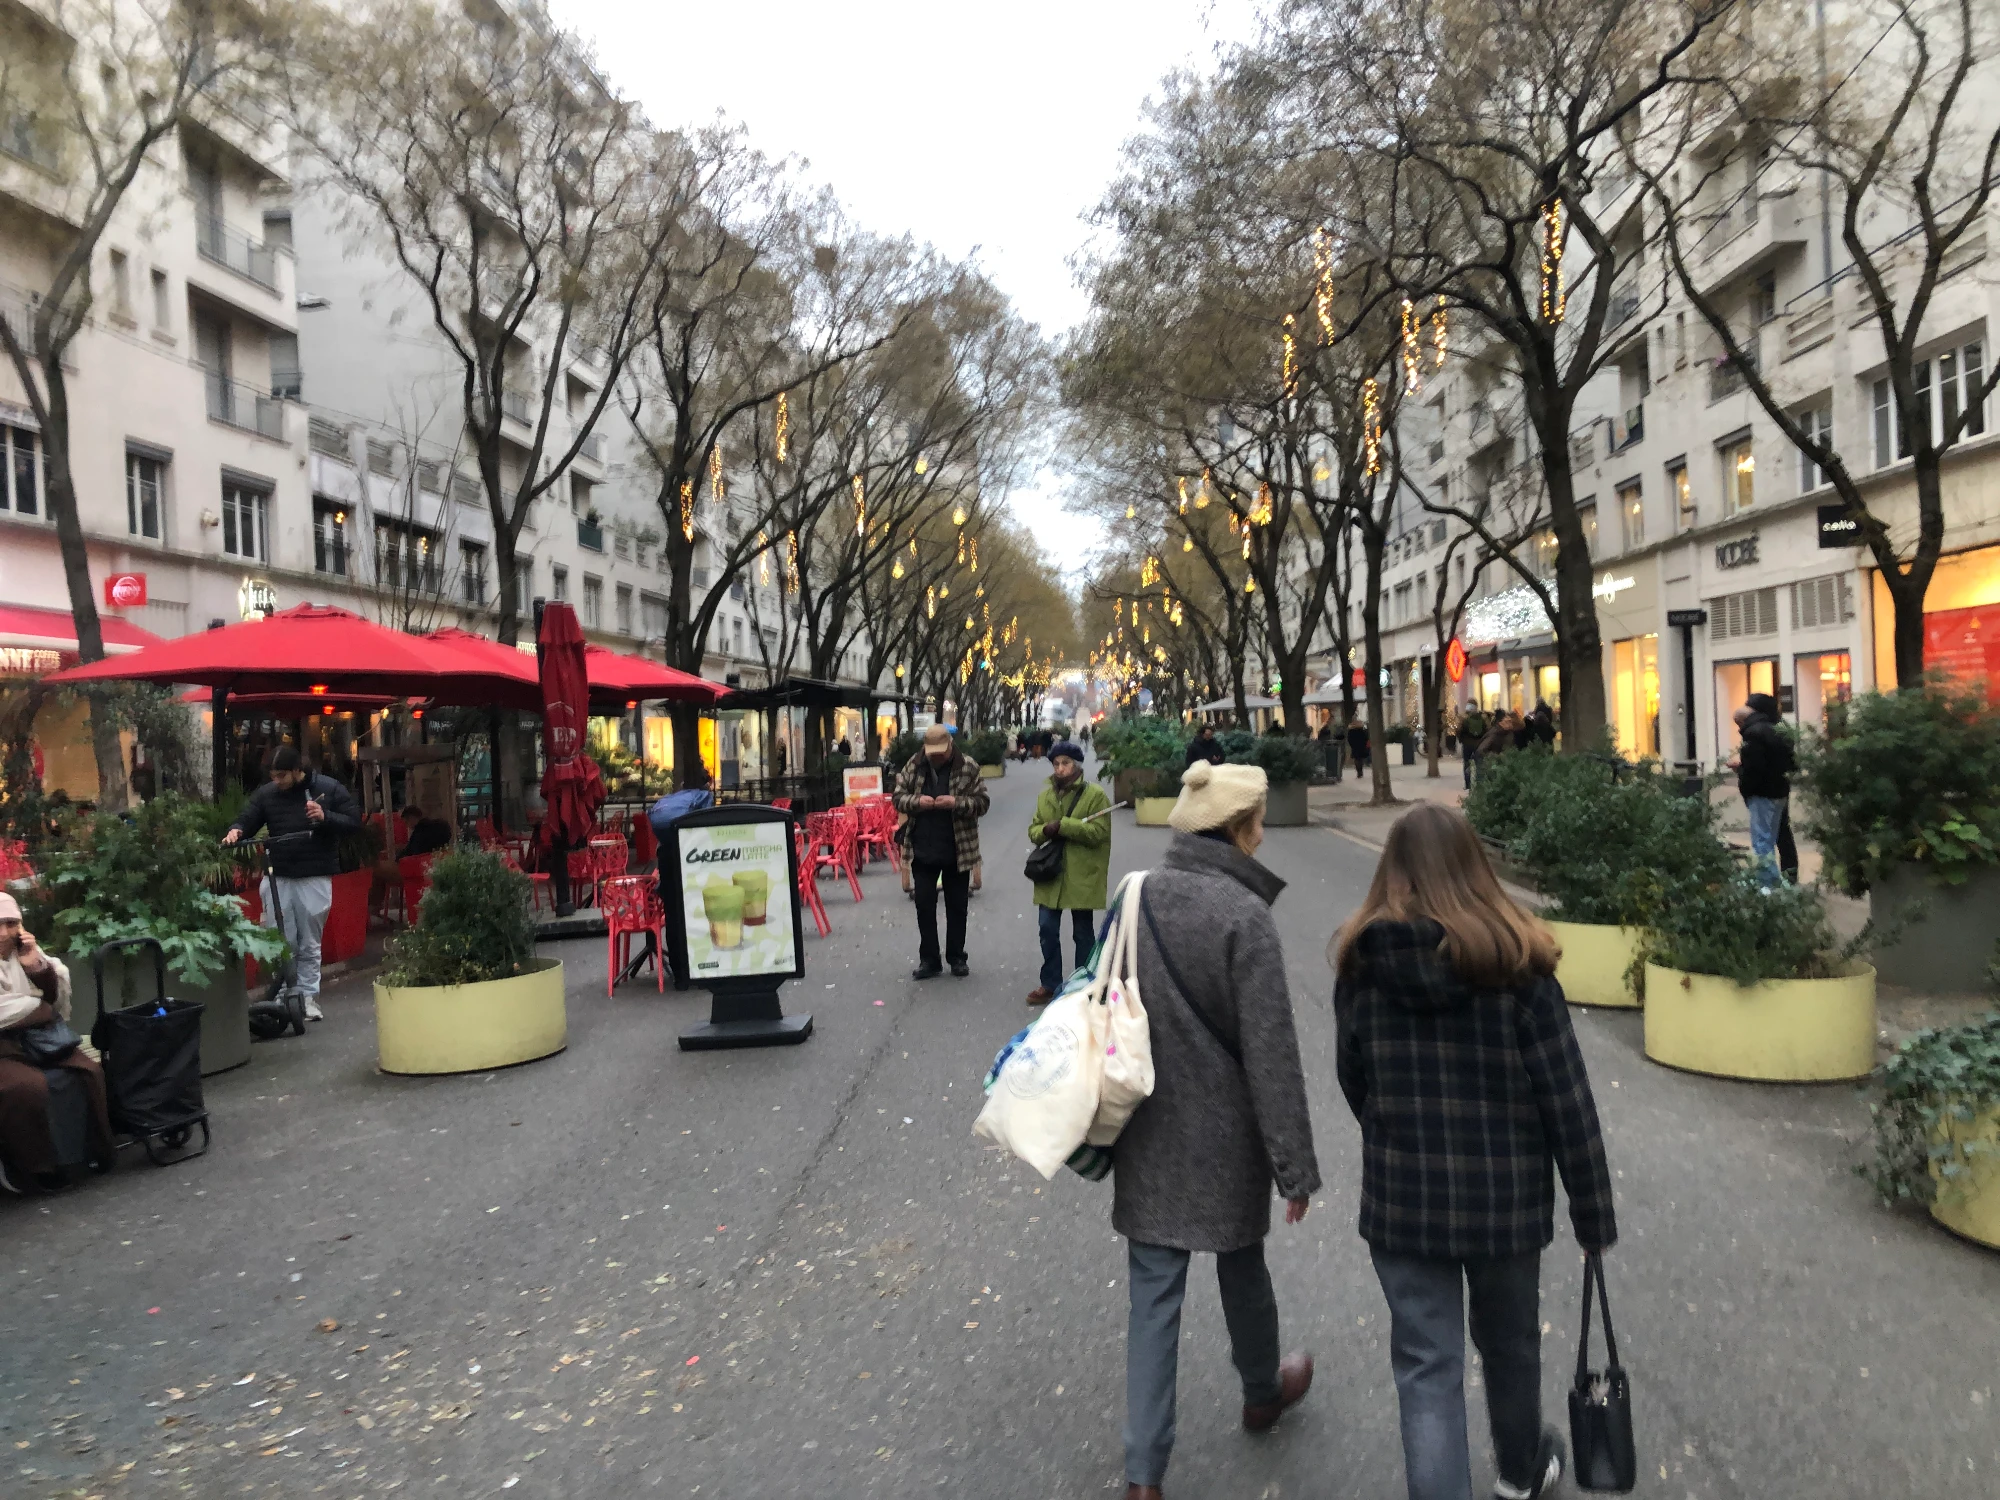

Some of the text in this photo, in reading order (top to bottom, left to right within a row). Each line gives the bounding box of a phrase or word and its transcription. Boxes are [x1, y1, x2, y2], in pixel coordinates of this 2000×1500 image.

[1822, 519, 1857, 532] celio
[743, 844, 783, 854] MATCHA
[686, 847, 742, 864] GREEN
[743, 852, 770, 860] LATTE
